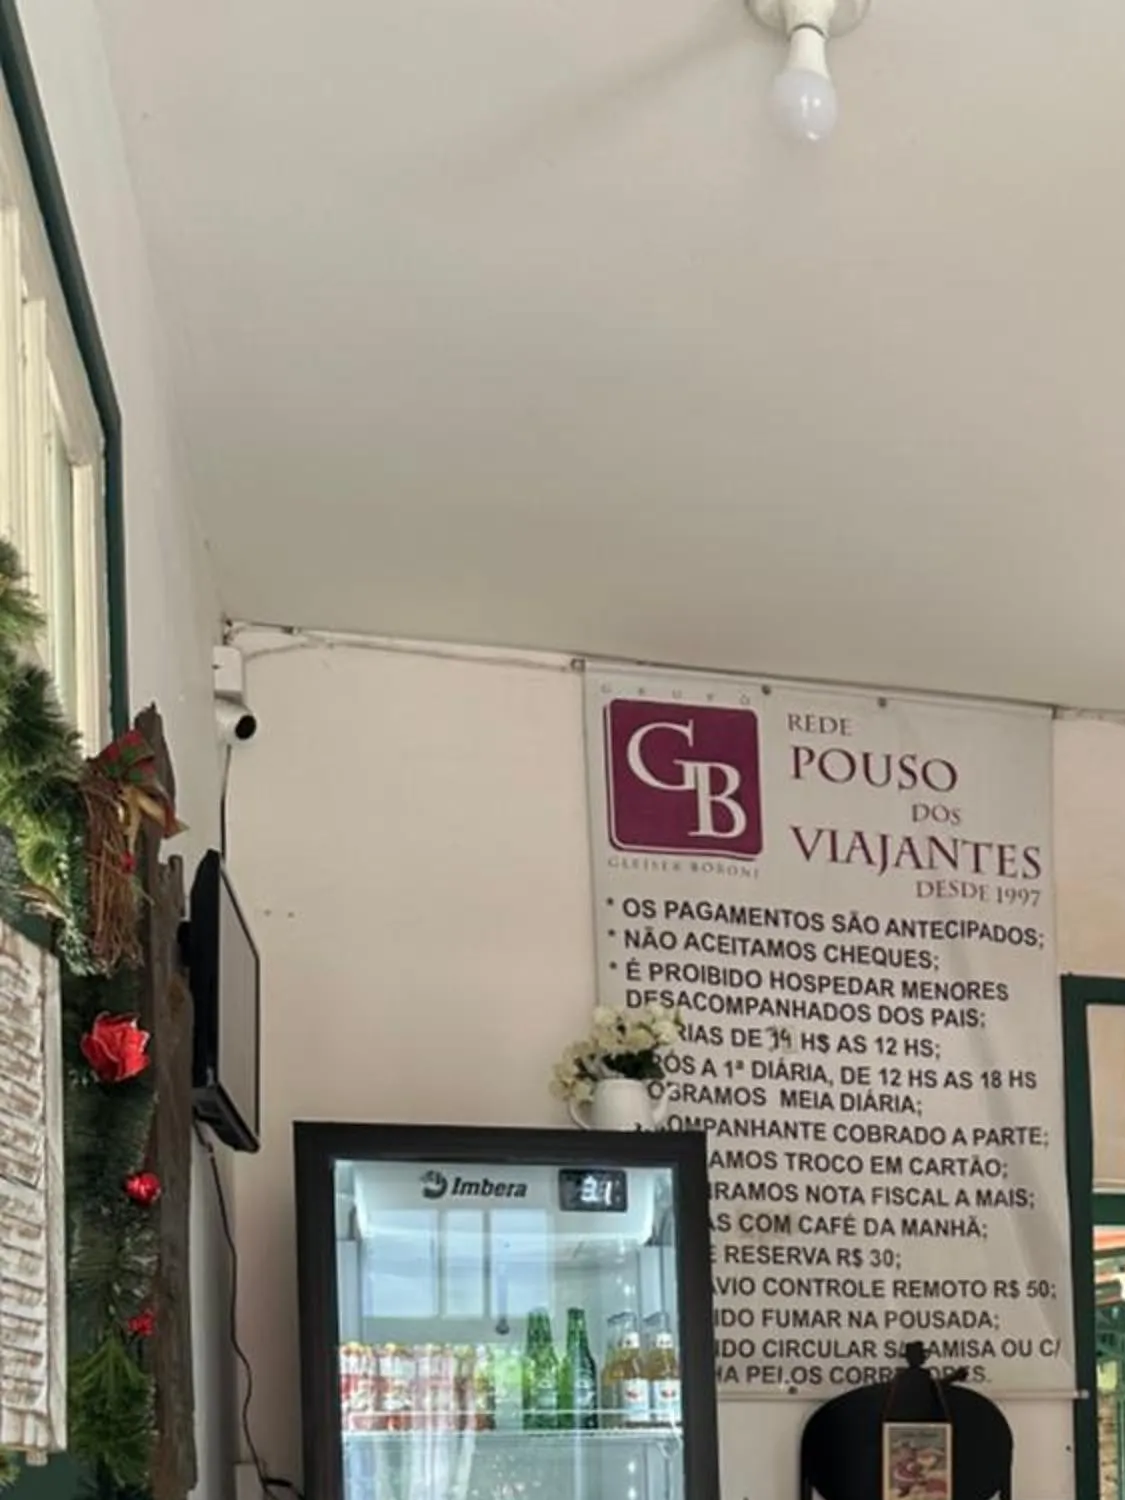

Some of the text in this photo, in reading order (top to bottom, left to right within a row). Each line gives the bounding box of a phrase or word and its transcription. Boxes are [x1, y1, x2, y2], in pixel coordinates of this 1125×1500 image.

[787, 713, 852, 736] REDE
[626, 719, 747, 839] GB
[791, 744, 957, 792] POUSO
[912, 803, 961, 825] DOS
[790, 826, 1042, 880] VIAJANTES
[916, 880, 1042, 907] DESDE 1997
[622, 898, 1045, 950] OS PAGAMENTOS SÃO ANTECIPADOS;
[624, 926, 940, 971] NÃO ACEITAMOS CHEQUES;
[626, 957, 1009, 1001] É PROIBIDO HOSPEDAR MENORES
[626, 989, 986, 1029] DESACOMPANHADOS DOS PAIS;
[731, 1028, 762, 1048] DE
[801, 1032, 831, 1053] HS
[837, 1034, 867, 1054] AS
[875, 1036, 897, 1056] 12
[904, 1039, 940, 1060] HS;
[702, 1058, 717, 1078] A
[724, 1060, 744, 1078] 1ª
[752, 1056, 834, 1087] DIÁRIA,
[840, 1066, 871, 1085] DE
[879, 1068, 901, 1087] 12
[908, 1069, 938, 1088] HS
[943, 1071, 973, 1089] AS
[981, 1070, 1002, 1089] 18
[1009, 1070, 1037, 1089] HS
[648, 1080, 922, 1116] OBRAMOS MEIA DIÁRIA;
[833, 1123, 946, 1146] COBRADO
[952, 1127, 967, 1146] A
[973, 1127, 1049, 1148] PARTE;
[709, 1150, 1009, 1180] AMOS TROCO EM CARTÃO;
[452, 1177, 528, 1198] Imbera
[806, 1185, 865, 1206] NOTA
[871, 1186, 949, 1207] FISCAL
[955, 1189, 970, 1207] A
[975, 1188, 1035, 1209] MAIS;
[739, 1213, 791, 1235] COM
[798, 1211, 857, 1236] CAFÉ
[863, 1217, 895, 1237] DA
[901, 1215, 988, 1240] MANHÃ;
[724, 1245, 831, 1266] RESERVA
[836, 1248, 863, 1268] R$
[869, 1249, 902, 1270] 30;
[763, 1277, 885, 1298] CONTROLE
[893, 1279, 987, 1299] REMOTO
[993, 1279, 1020, 1299] R$
[1026, 1279, 1057, 1300] 50;
[762, 1308, 841, 1328] FUMAR
[848, 1310, 879, 1329] NA
[884, 1310, 1000, 1331] POUSADA;
[762, 1338, 878, 1359] CIRCULAR
[1001, 1338, 1034, 1358] OU
[1039, 1337, 1062, 1359] C/
[746, 1365, 822, 1385] PELOS
